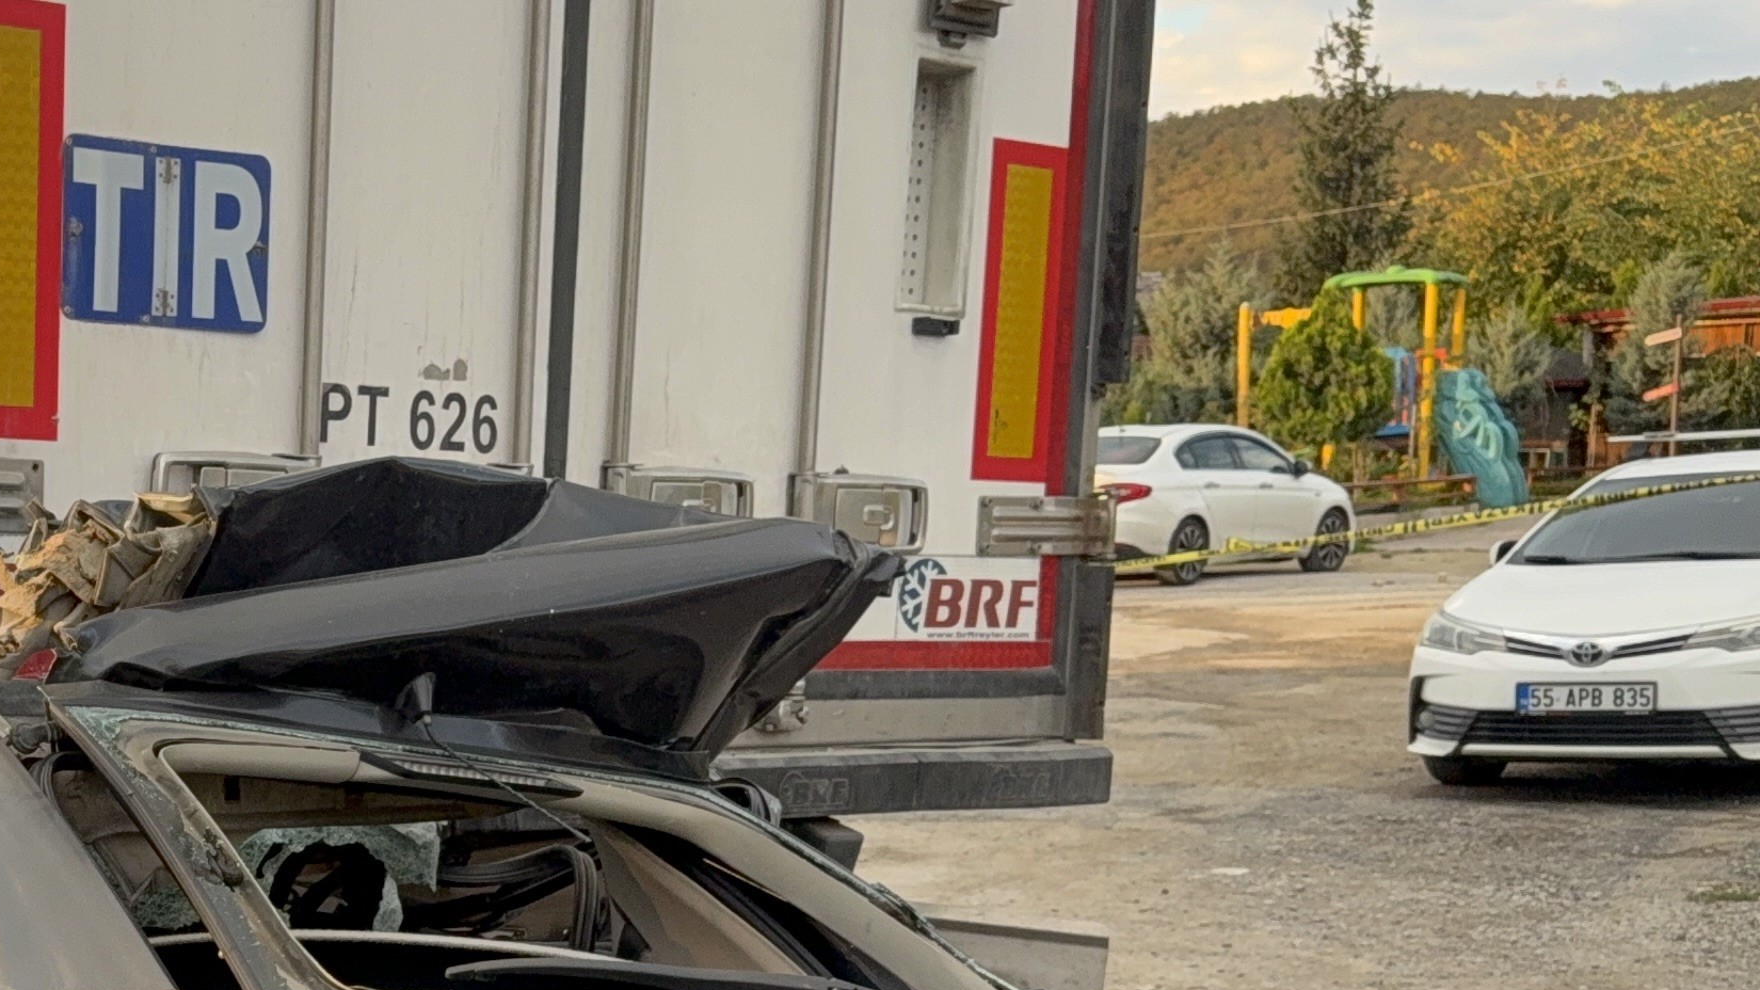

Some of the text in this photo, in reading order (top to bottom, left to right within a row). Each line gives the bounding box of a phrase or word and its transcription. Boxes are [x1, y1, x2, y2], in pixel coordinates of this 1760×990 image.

[72, 146, 264, 323] TIR
[319, 382, 498, 454] PT 626
[923, 578, 1037, 629] BRF
[1530, 688, 1554, 708] 55
[1565, 688, 1603, 708] APB
[1613, 687, 1651, 708] 835
